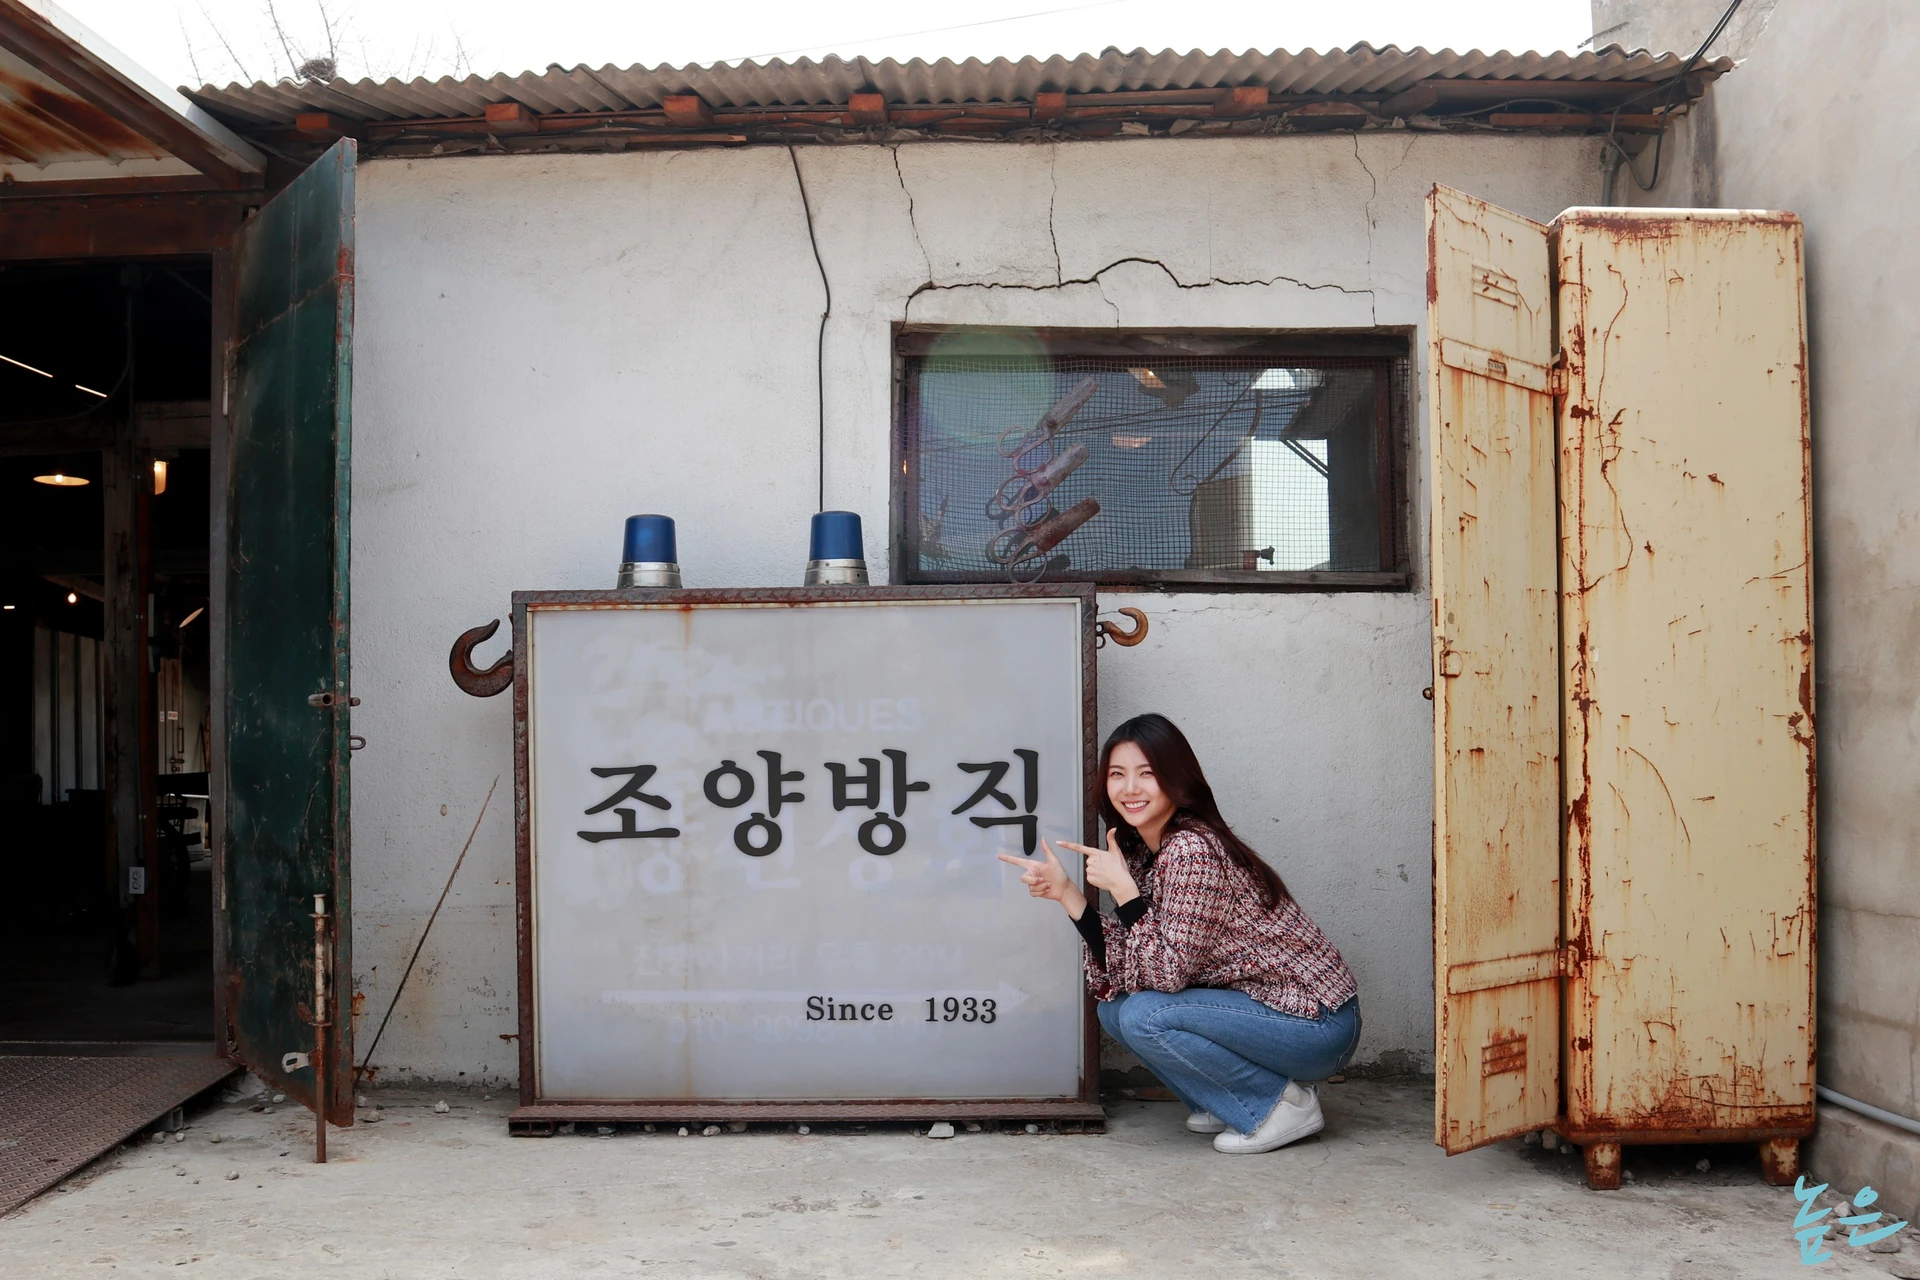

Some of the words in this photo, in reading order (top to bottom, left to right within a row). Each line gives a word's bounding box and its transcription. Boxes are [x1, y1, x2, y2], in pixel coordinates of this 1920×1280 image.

[576, 748, 1038, 857] 조양방직
[805, 996, 894, 1021] Since
[925, 996, 998, 1023] 1933
